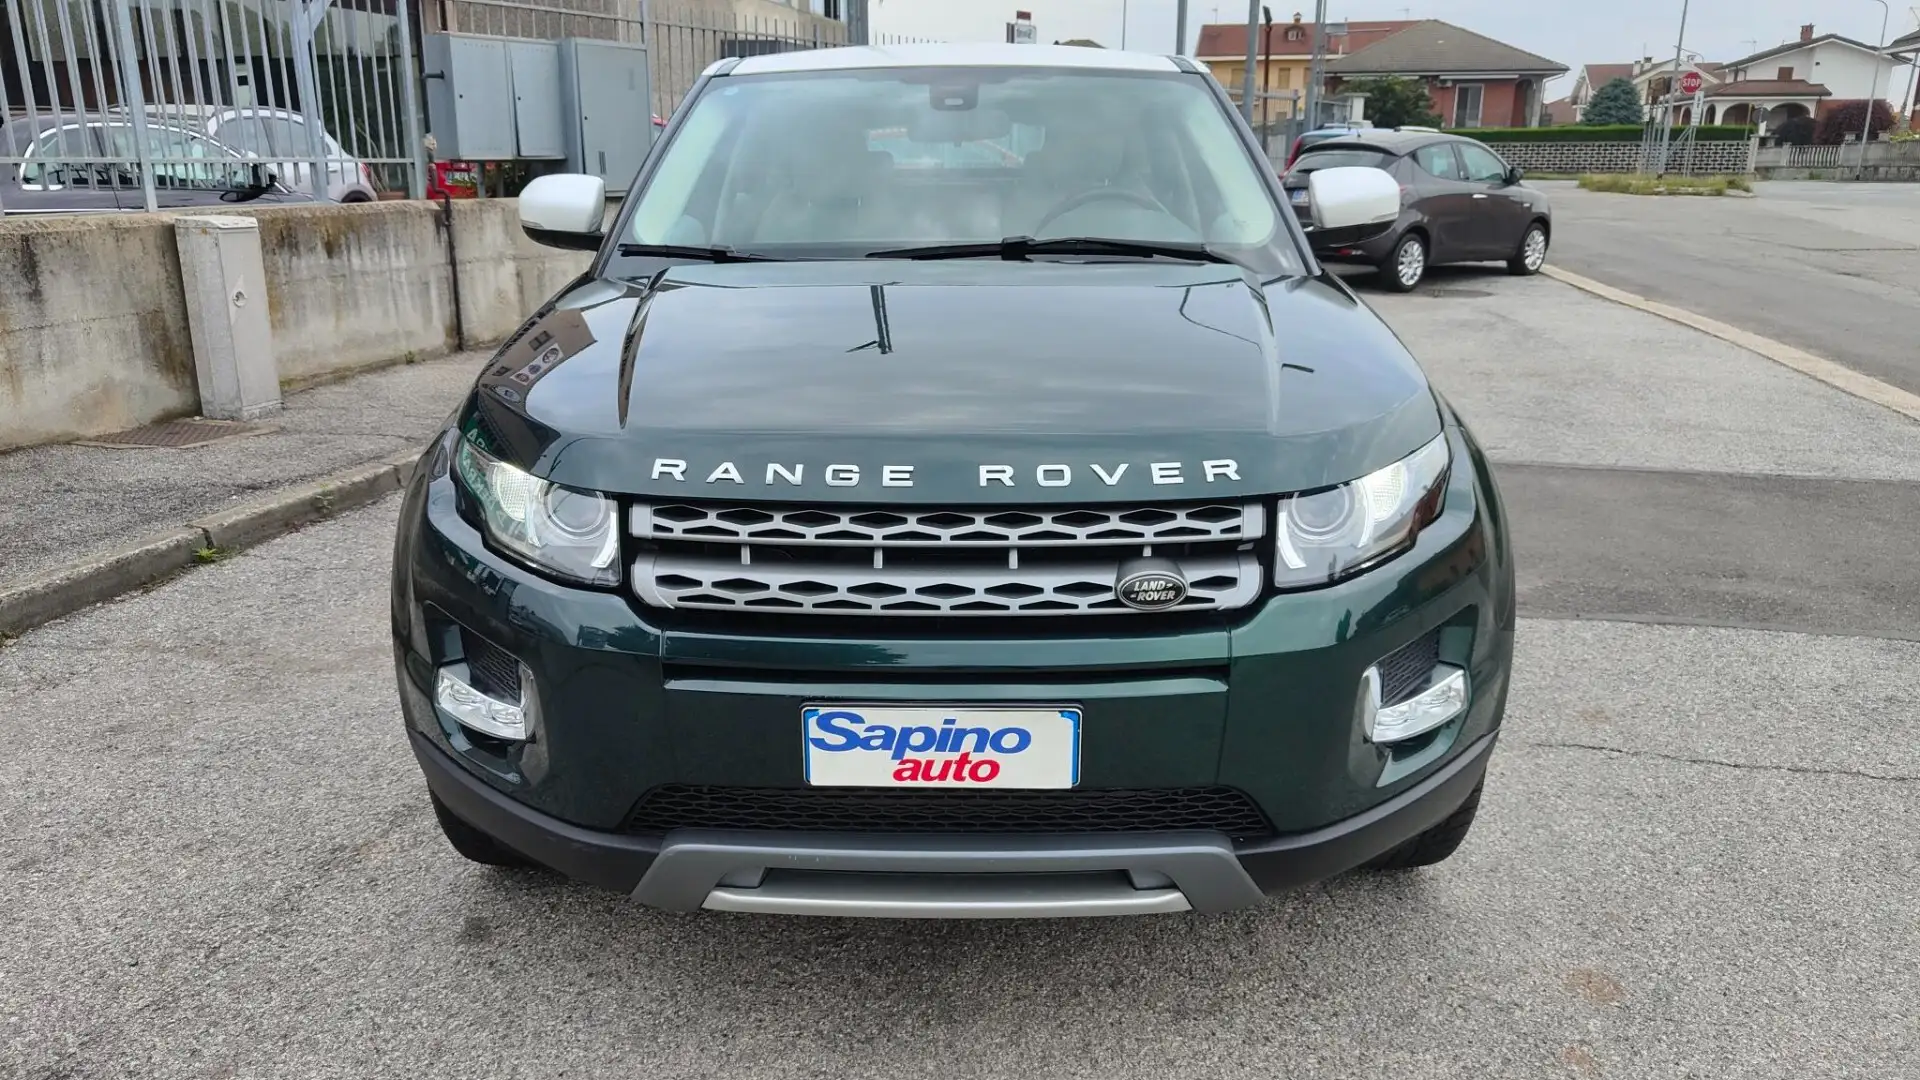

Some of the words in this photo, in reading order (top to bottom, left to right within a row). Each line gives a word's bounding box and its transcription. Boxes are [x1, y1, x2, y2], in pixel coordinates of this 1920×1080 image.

[1682, 78, 1702, 87] STOP
[651, 458, 915, 488] RANGE
[979, 459, 1241, 487] ROVER
[1134, 580, 1166, 591] LAND
[1136, 590, 1176, 601] ROVER
[809, 711, 1032, 760] Sapino
[892, 751, 1001, 783] auto
